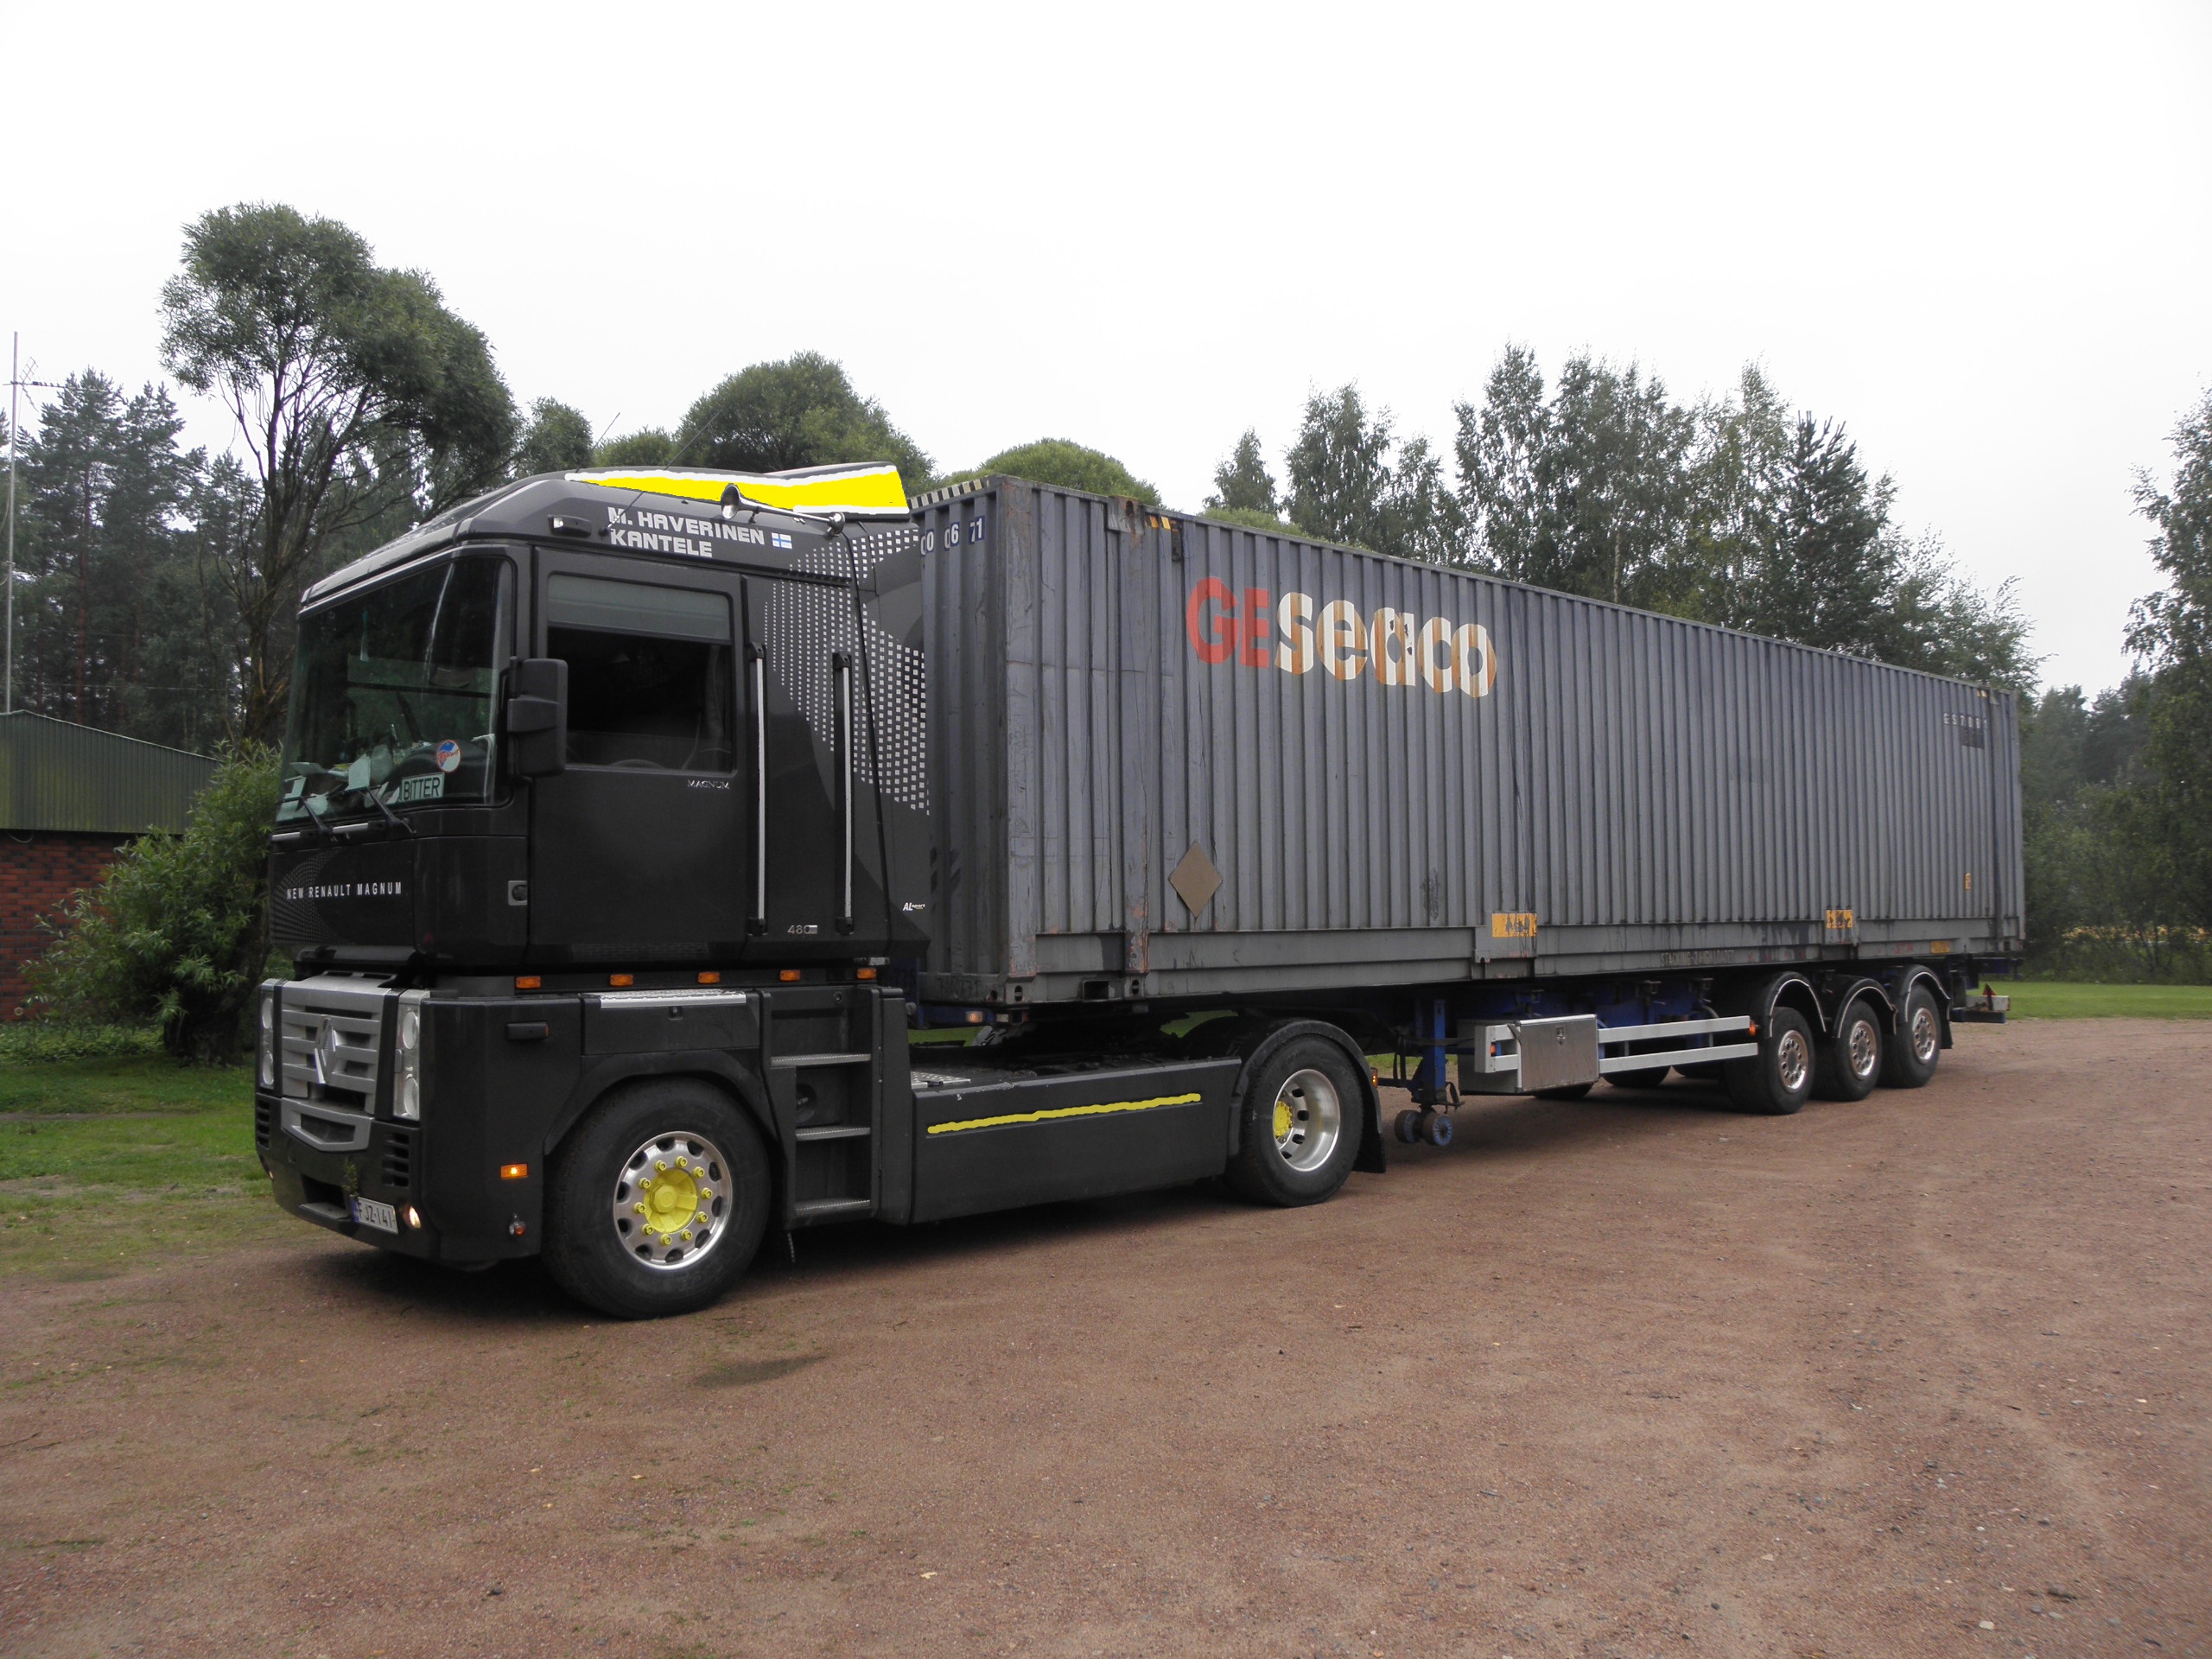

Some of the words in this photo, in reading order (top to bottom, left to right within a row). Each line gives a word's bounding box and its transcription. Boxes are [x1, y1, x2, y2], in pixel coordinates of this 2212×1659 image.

[607, 506, 632, 525] M.
[637, 511, 765, 544] HAVERINEN
[610, 529, 713, 557] KANTELE
[404, 777, 441, 801] BITTER
[287, 888, 304, 899] NEW
[308, 884, 352, 898] RENAULT
[357, 881, 402, 895] MAGNUM
